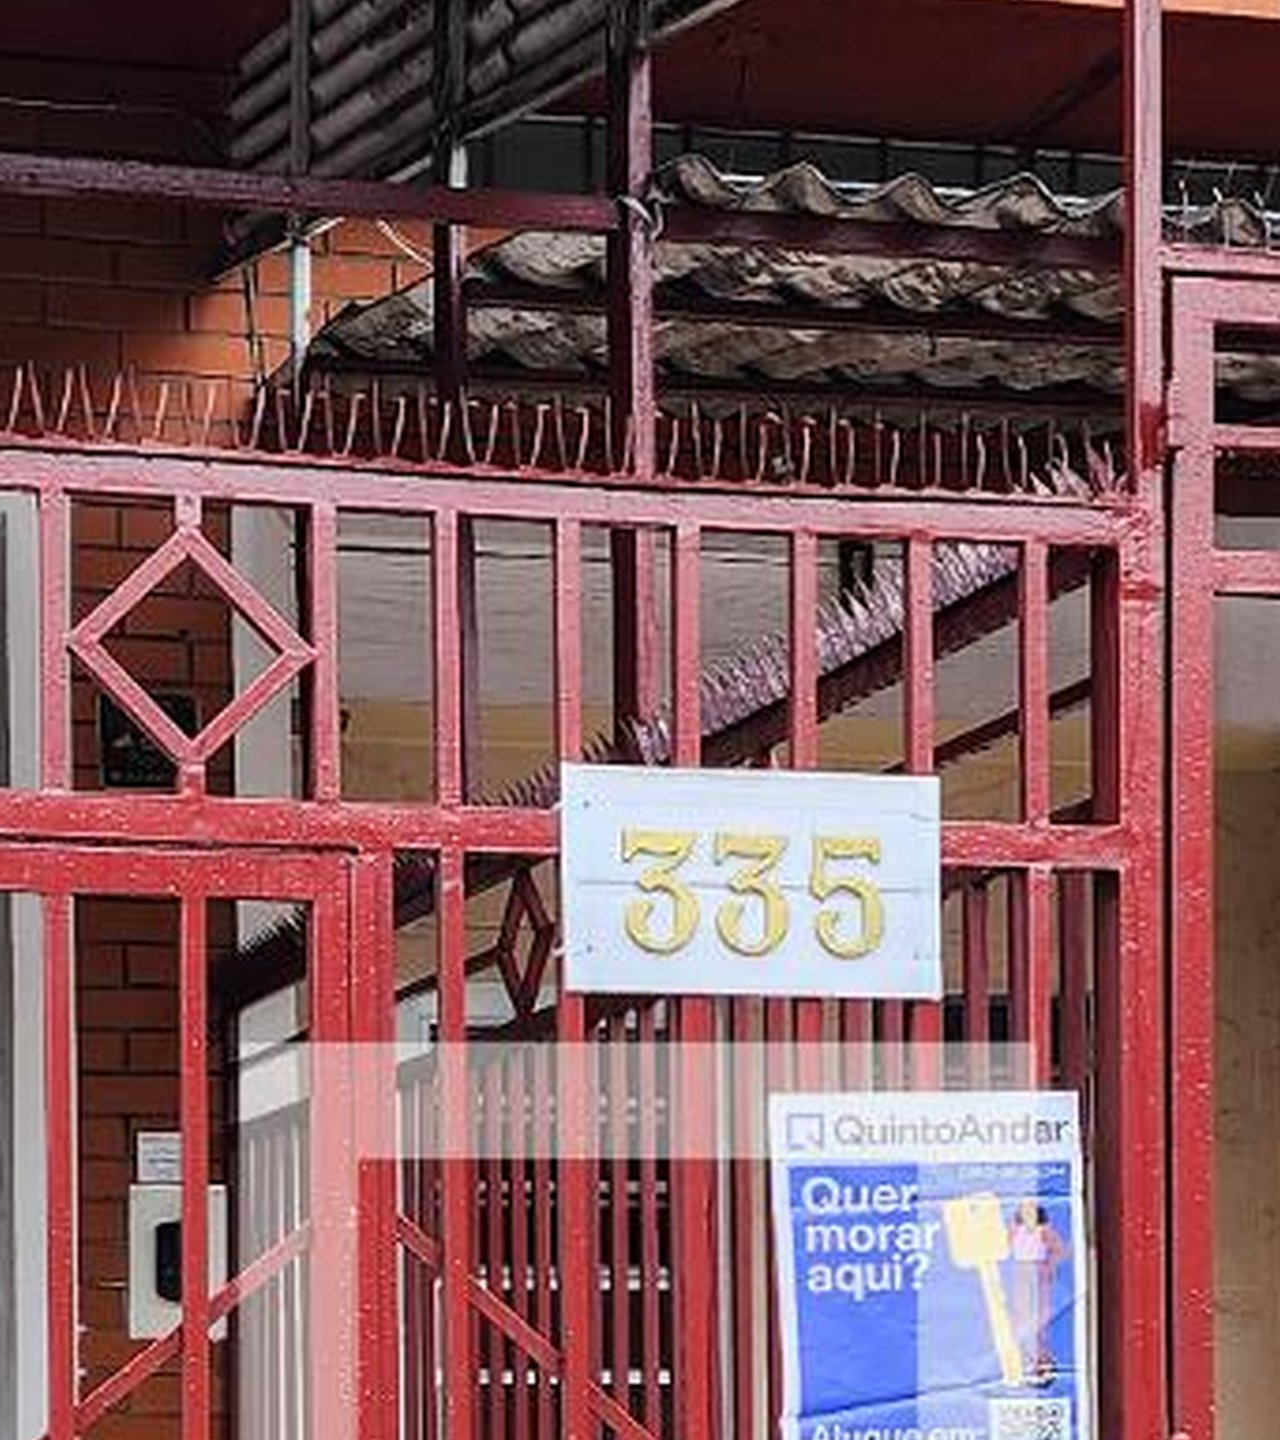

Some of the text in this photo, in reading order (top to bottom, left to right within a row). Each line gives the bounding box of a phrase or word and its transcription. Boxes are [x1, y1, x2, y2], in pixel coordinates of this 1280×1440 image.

[621, 829, 883, 960] 335
[834, 1114, 1069, 1144] QuintoAndar
[801, 1176, 918, 1213] Quer
[806, 1222, 941, 1252] morar
[807, 1252, 929, 1301] aqui?
